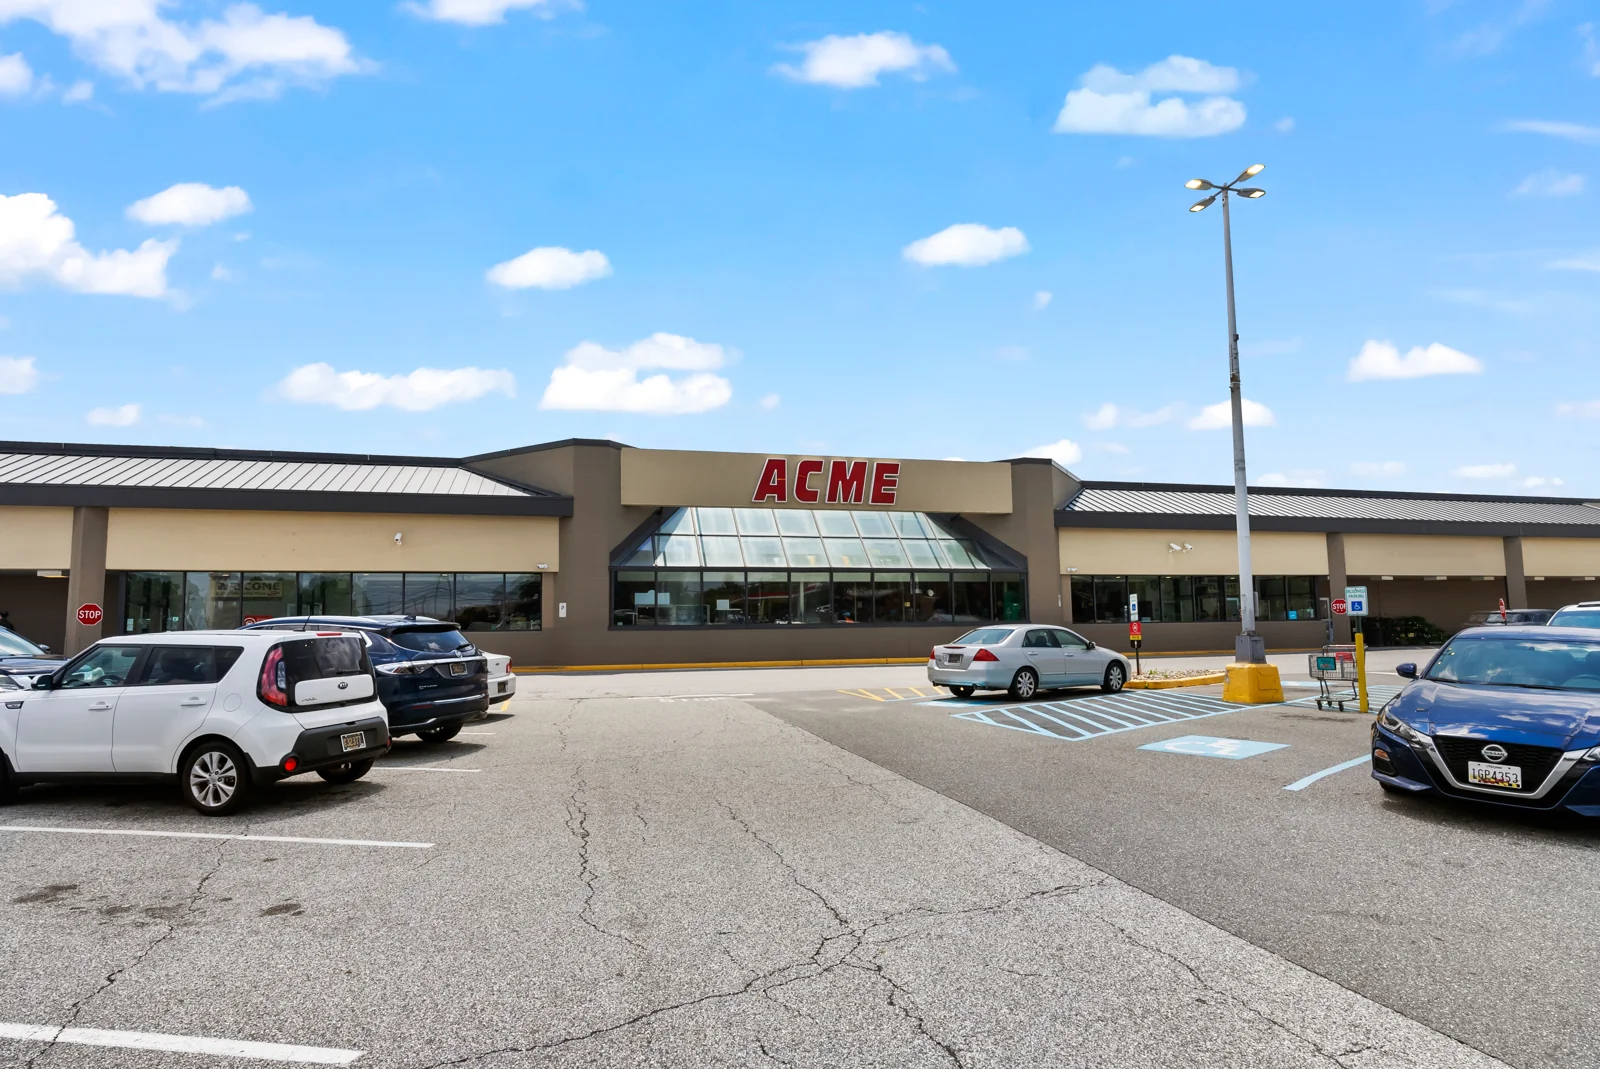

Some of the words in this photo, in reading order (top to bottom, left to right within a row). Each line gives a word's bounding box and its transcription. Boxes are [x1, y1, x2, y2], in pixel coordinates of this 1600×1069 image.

[751, 457, 901, 506] ACME
[216, 582, 280, 591] WLCOME
[78, 610, 101, 619] STOP
